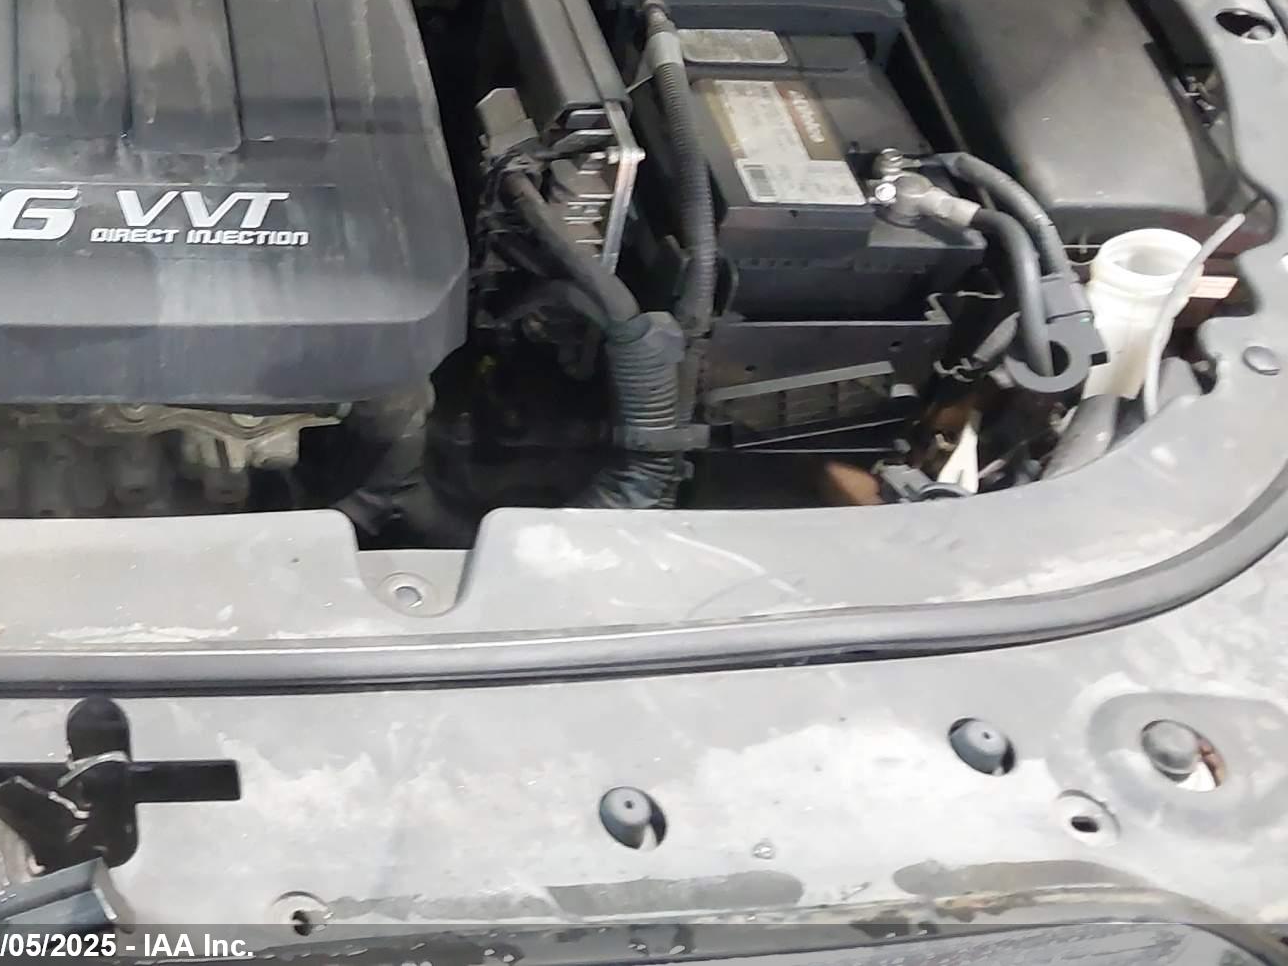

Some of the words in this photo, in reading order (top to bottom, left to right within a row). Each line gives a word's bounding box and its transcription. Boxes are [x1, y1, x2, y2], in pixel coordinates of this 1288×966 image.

[115, 189, 291, 229] VVT
[90, 227, 179, 245] DIRECT
[186, 228, 309, 247] INJECTION
